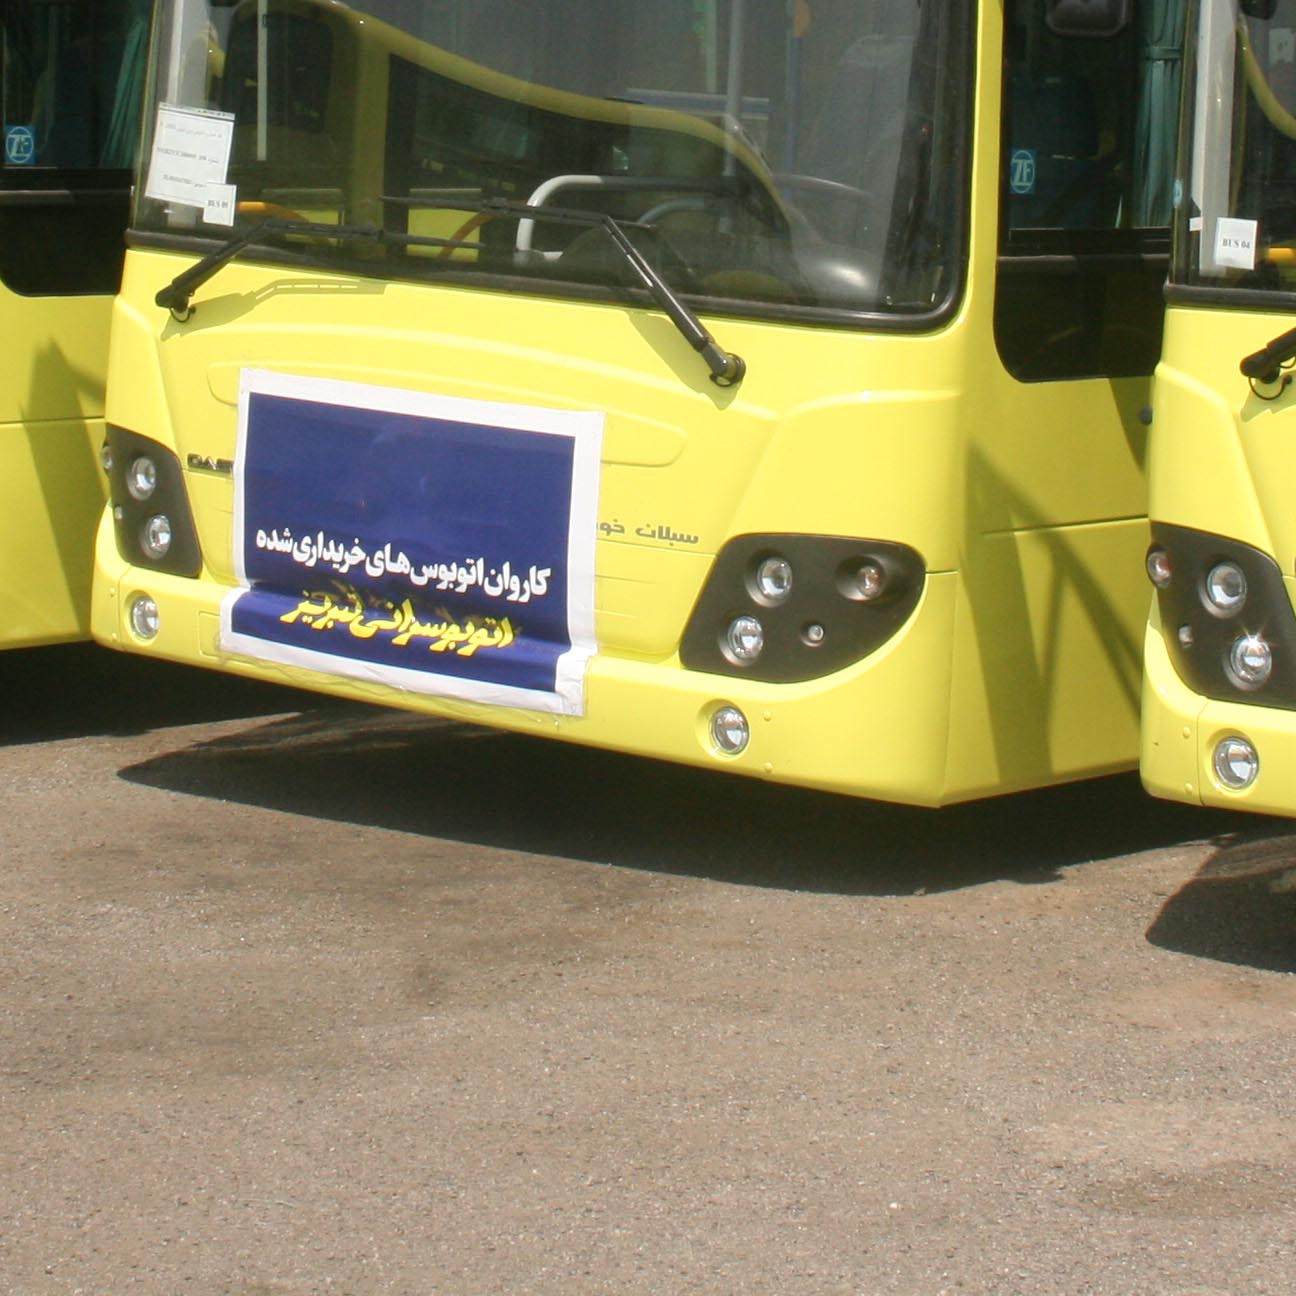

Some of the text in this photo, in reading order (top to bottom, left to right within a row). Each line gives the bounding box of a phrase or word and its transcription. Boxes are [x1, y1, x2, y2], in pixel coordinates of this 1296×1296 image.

[1222, 238, 1240, 249] BUS
[256, 527, 294, 554] شده
[293, 530, 366, 574] خریداری
[635, 523, 699, 547] سبلان
[484, 560, 552, 603] کاروان
[279, 589, 363, 630] تبریز
